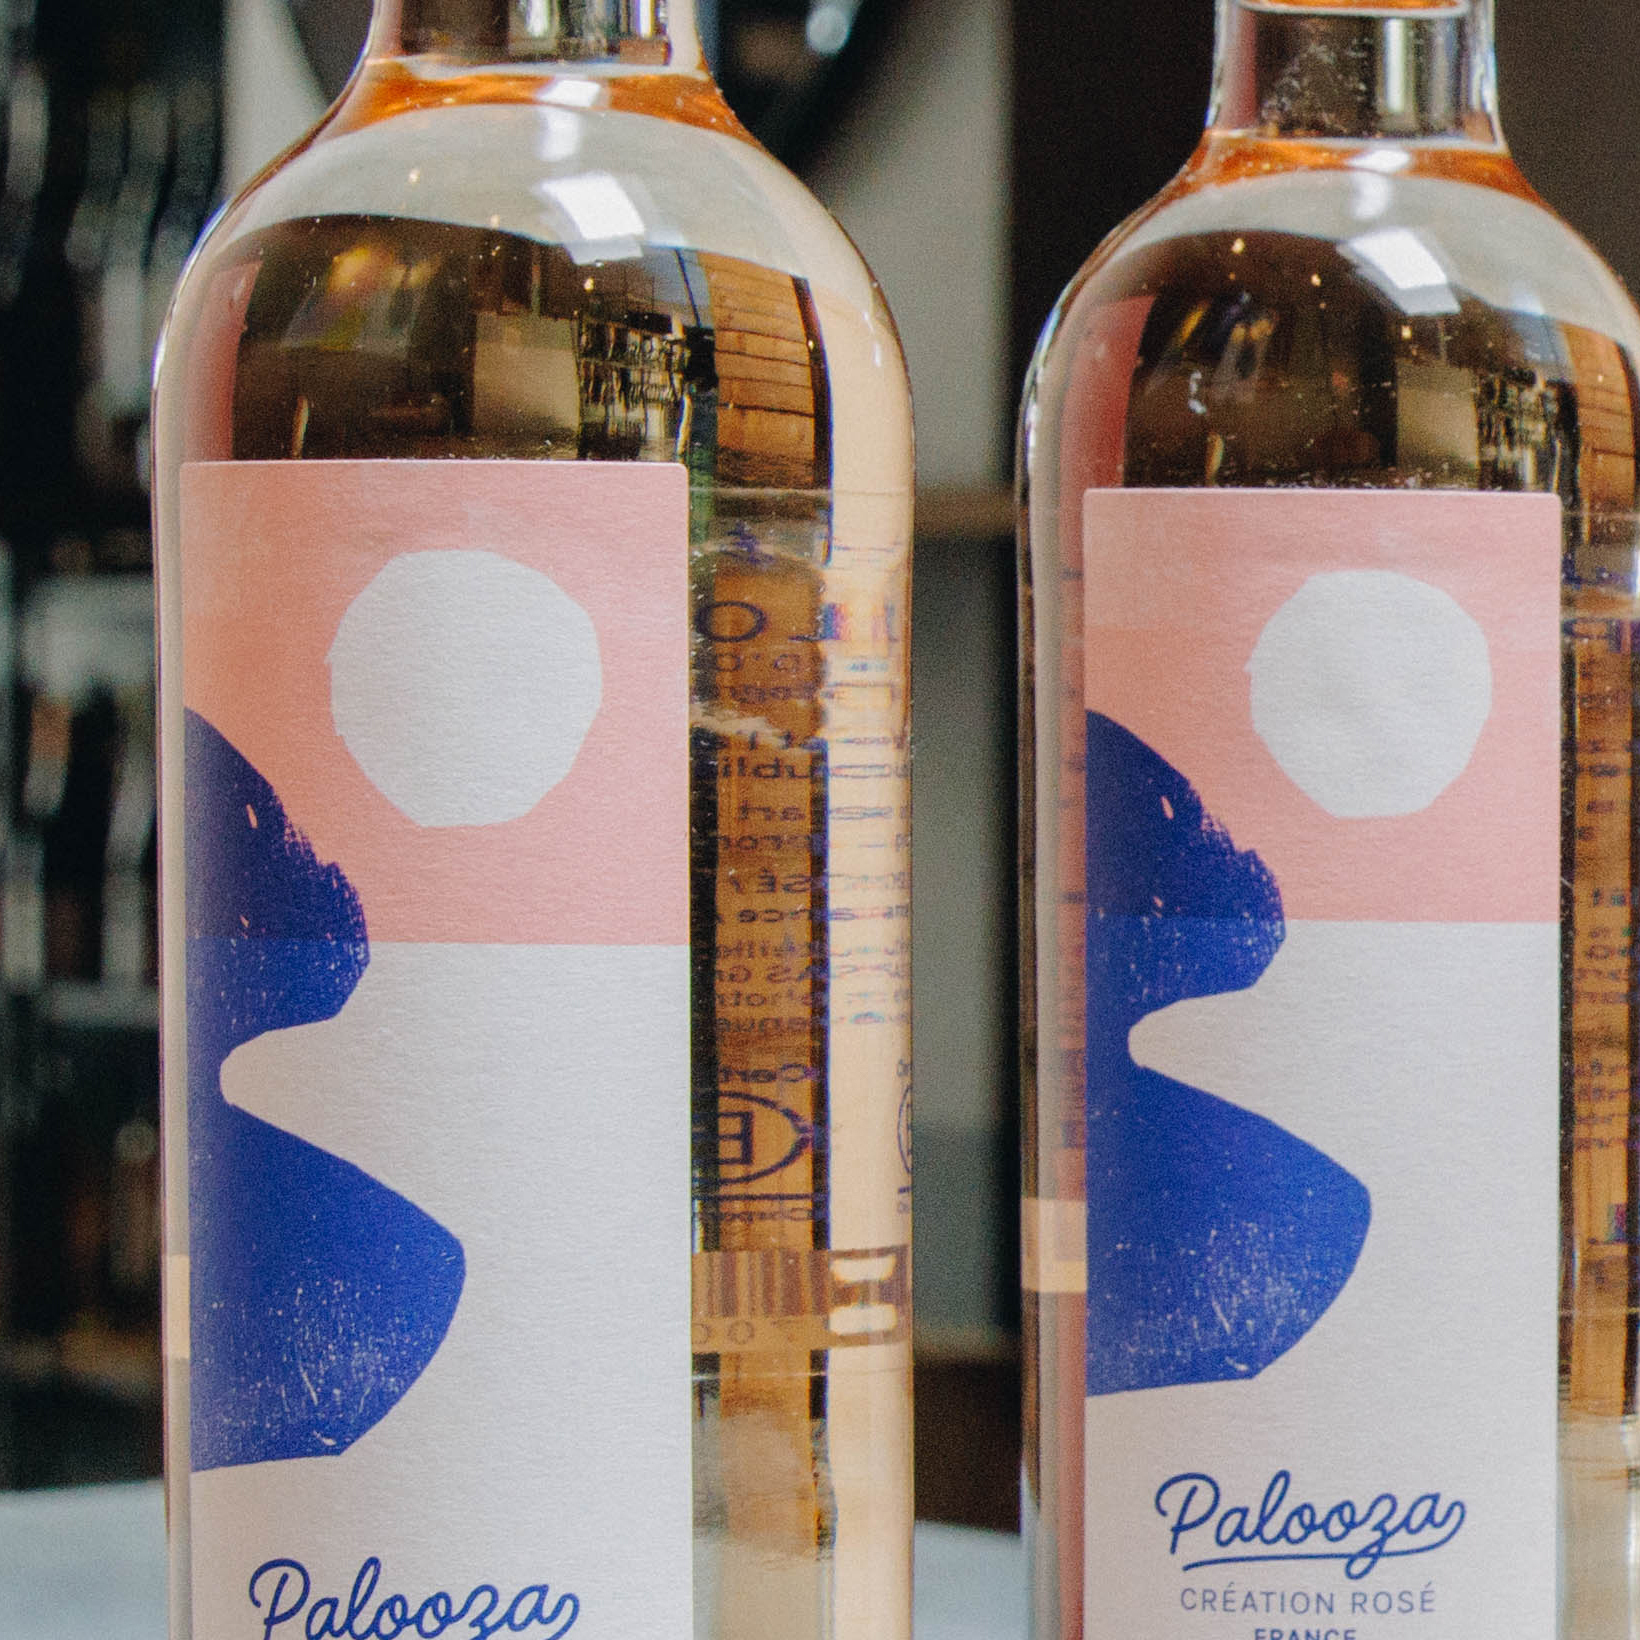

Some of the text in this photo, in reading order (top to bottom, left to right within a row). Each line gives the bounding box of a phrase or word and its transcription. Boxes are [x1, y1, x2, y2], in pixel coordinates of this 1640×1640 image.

[1155, 1470, 1466, 1580] Palooza
[1180, 1581, 1436, 1614] CRÉATION ROSÉ
